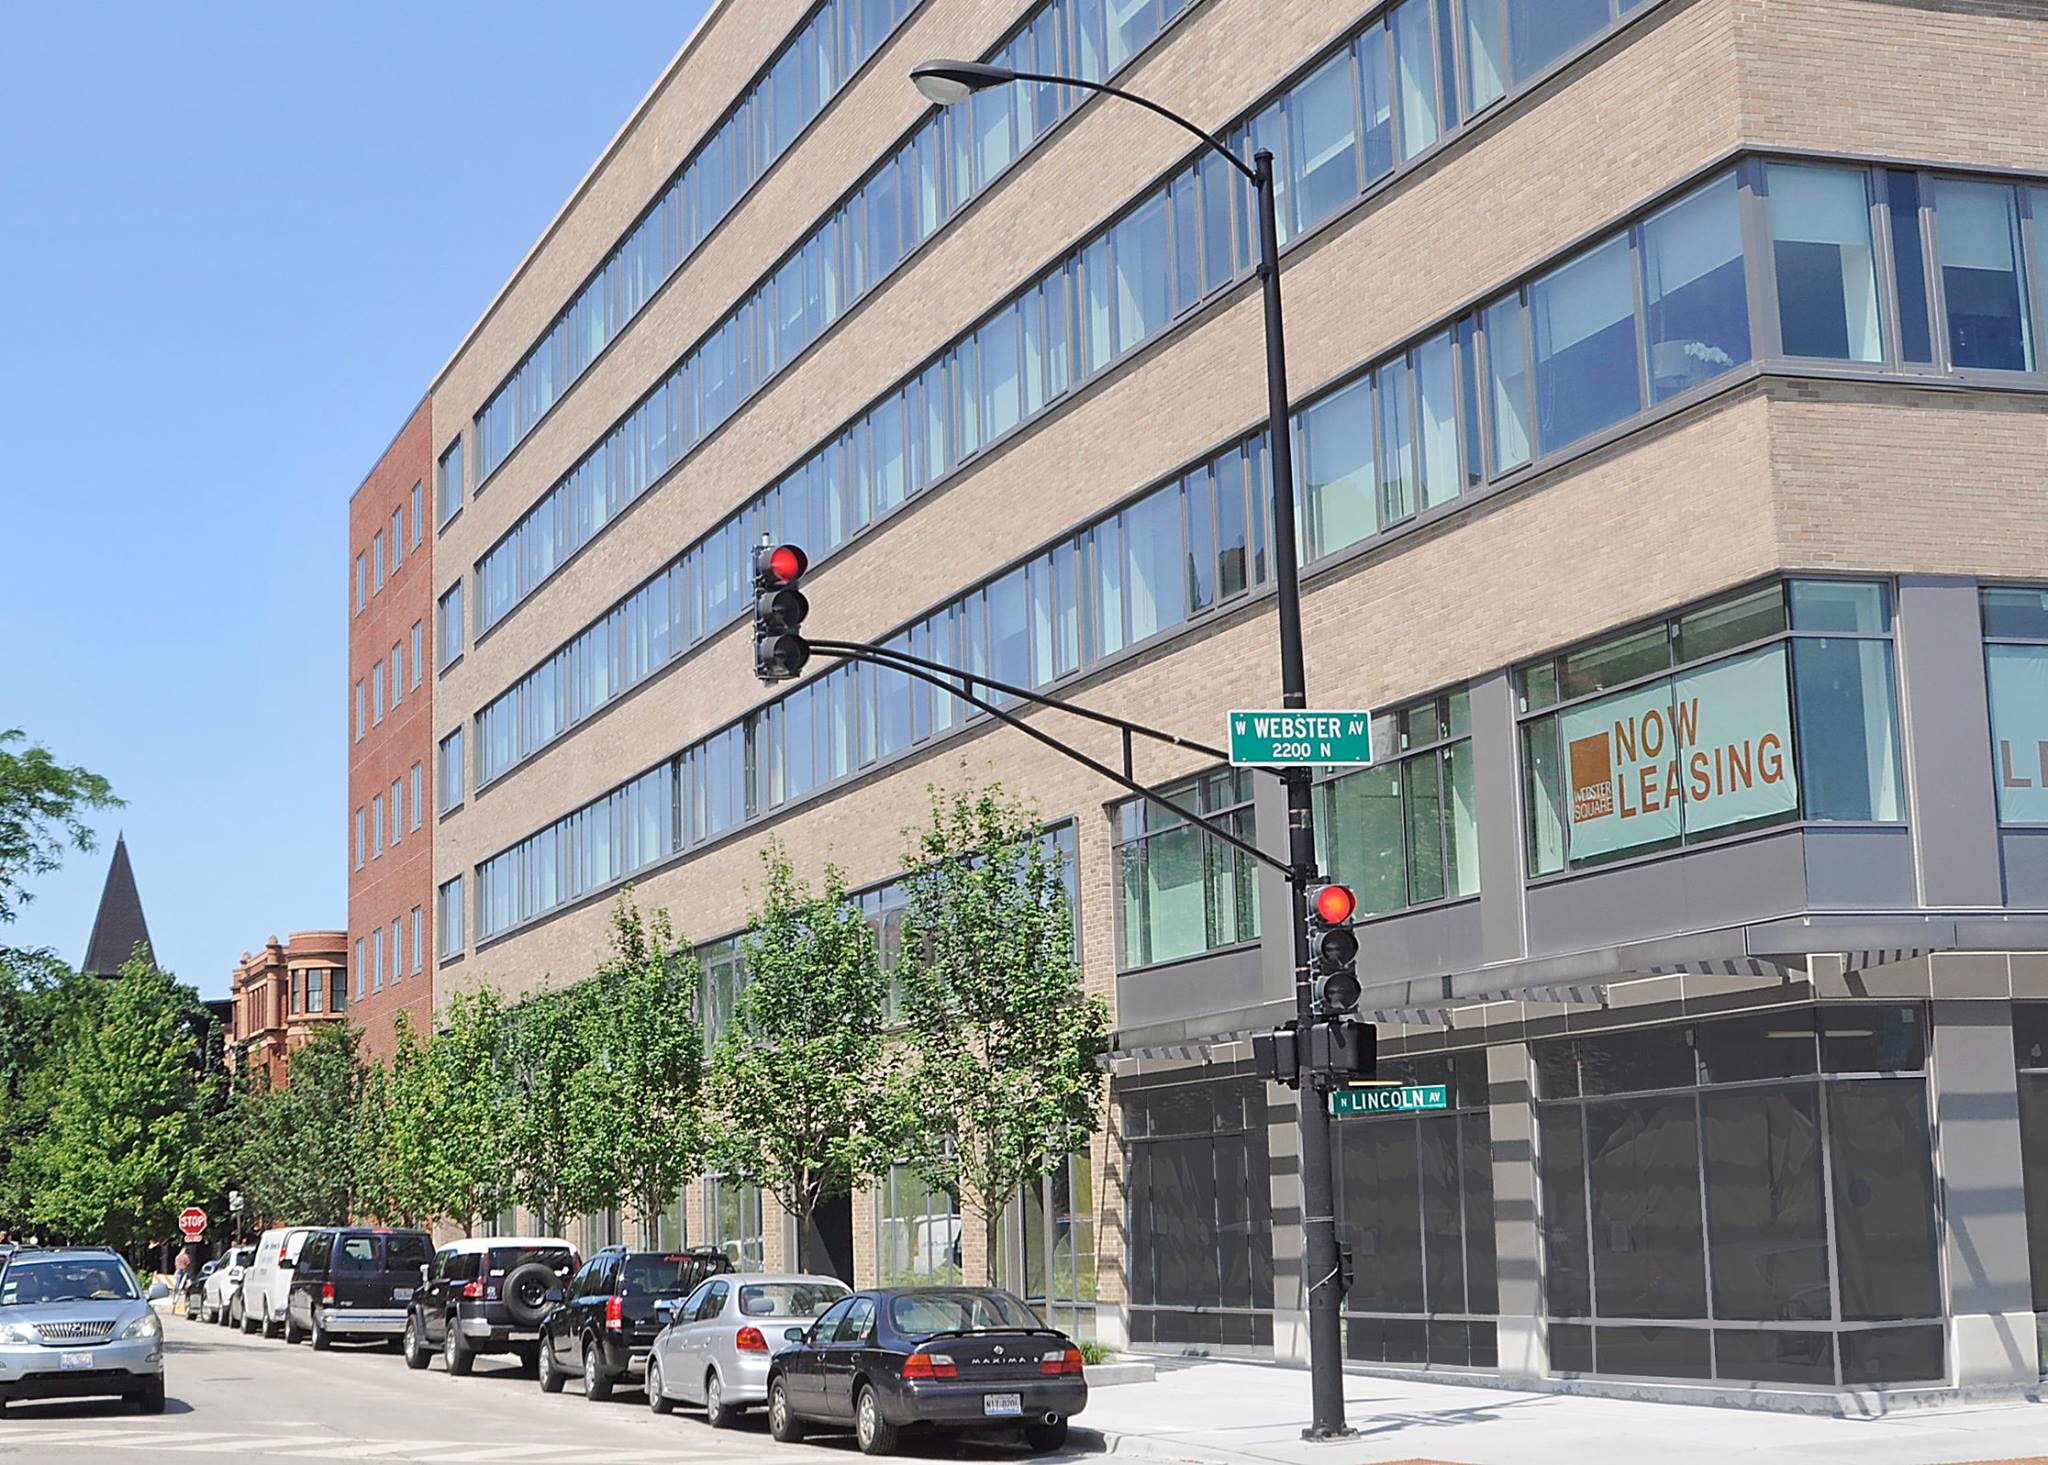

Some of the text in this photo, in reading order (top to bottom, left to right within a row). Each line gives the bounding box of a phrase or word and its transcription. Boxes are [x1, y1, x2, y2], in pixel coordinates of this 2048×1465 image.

[1235, 718, 1363, 738] W WEBSTER AV
[1615, 698, 1698, 765] NOW
[1272, 743, 1331, 757] 2200 N
[2000, 740, 2048, 787] L
[1618, 733, 1784, 818] LEASING
[1574, 781, 1612, 802] WEBSTER
[1575, 796, 1613, 820] SQUARE
[1341, 1090, 1441, 1110] N LINCOLN AV
[181, 1216, 204, 1227] STOP
